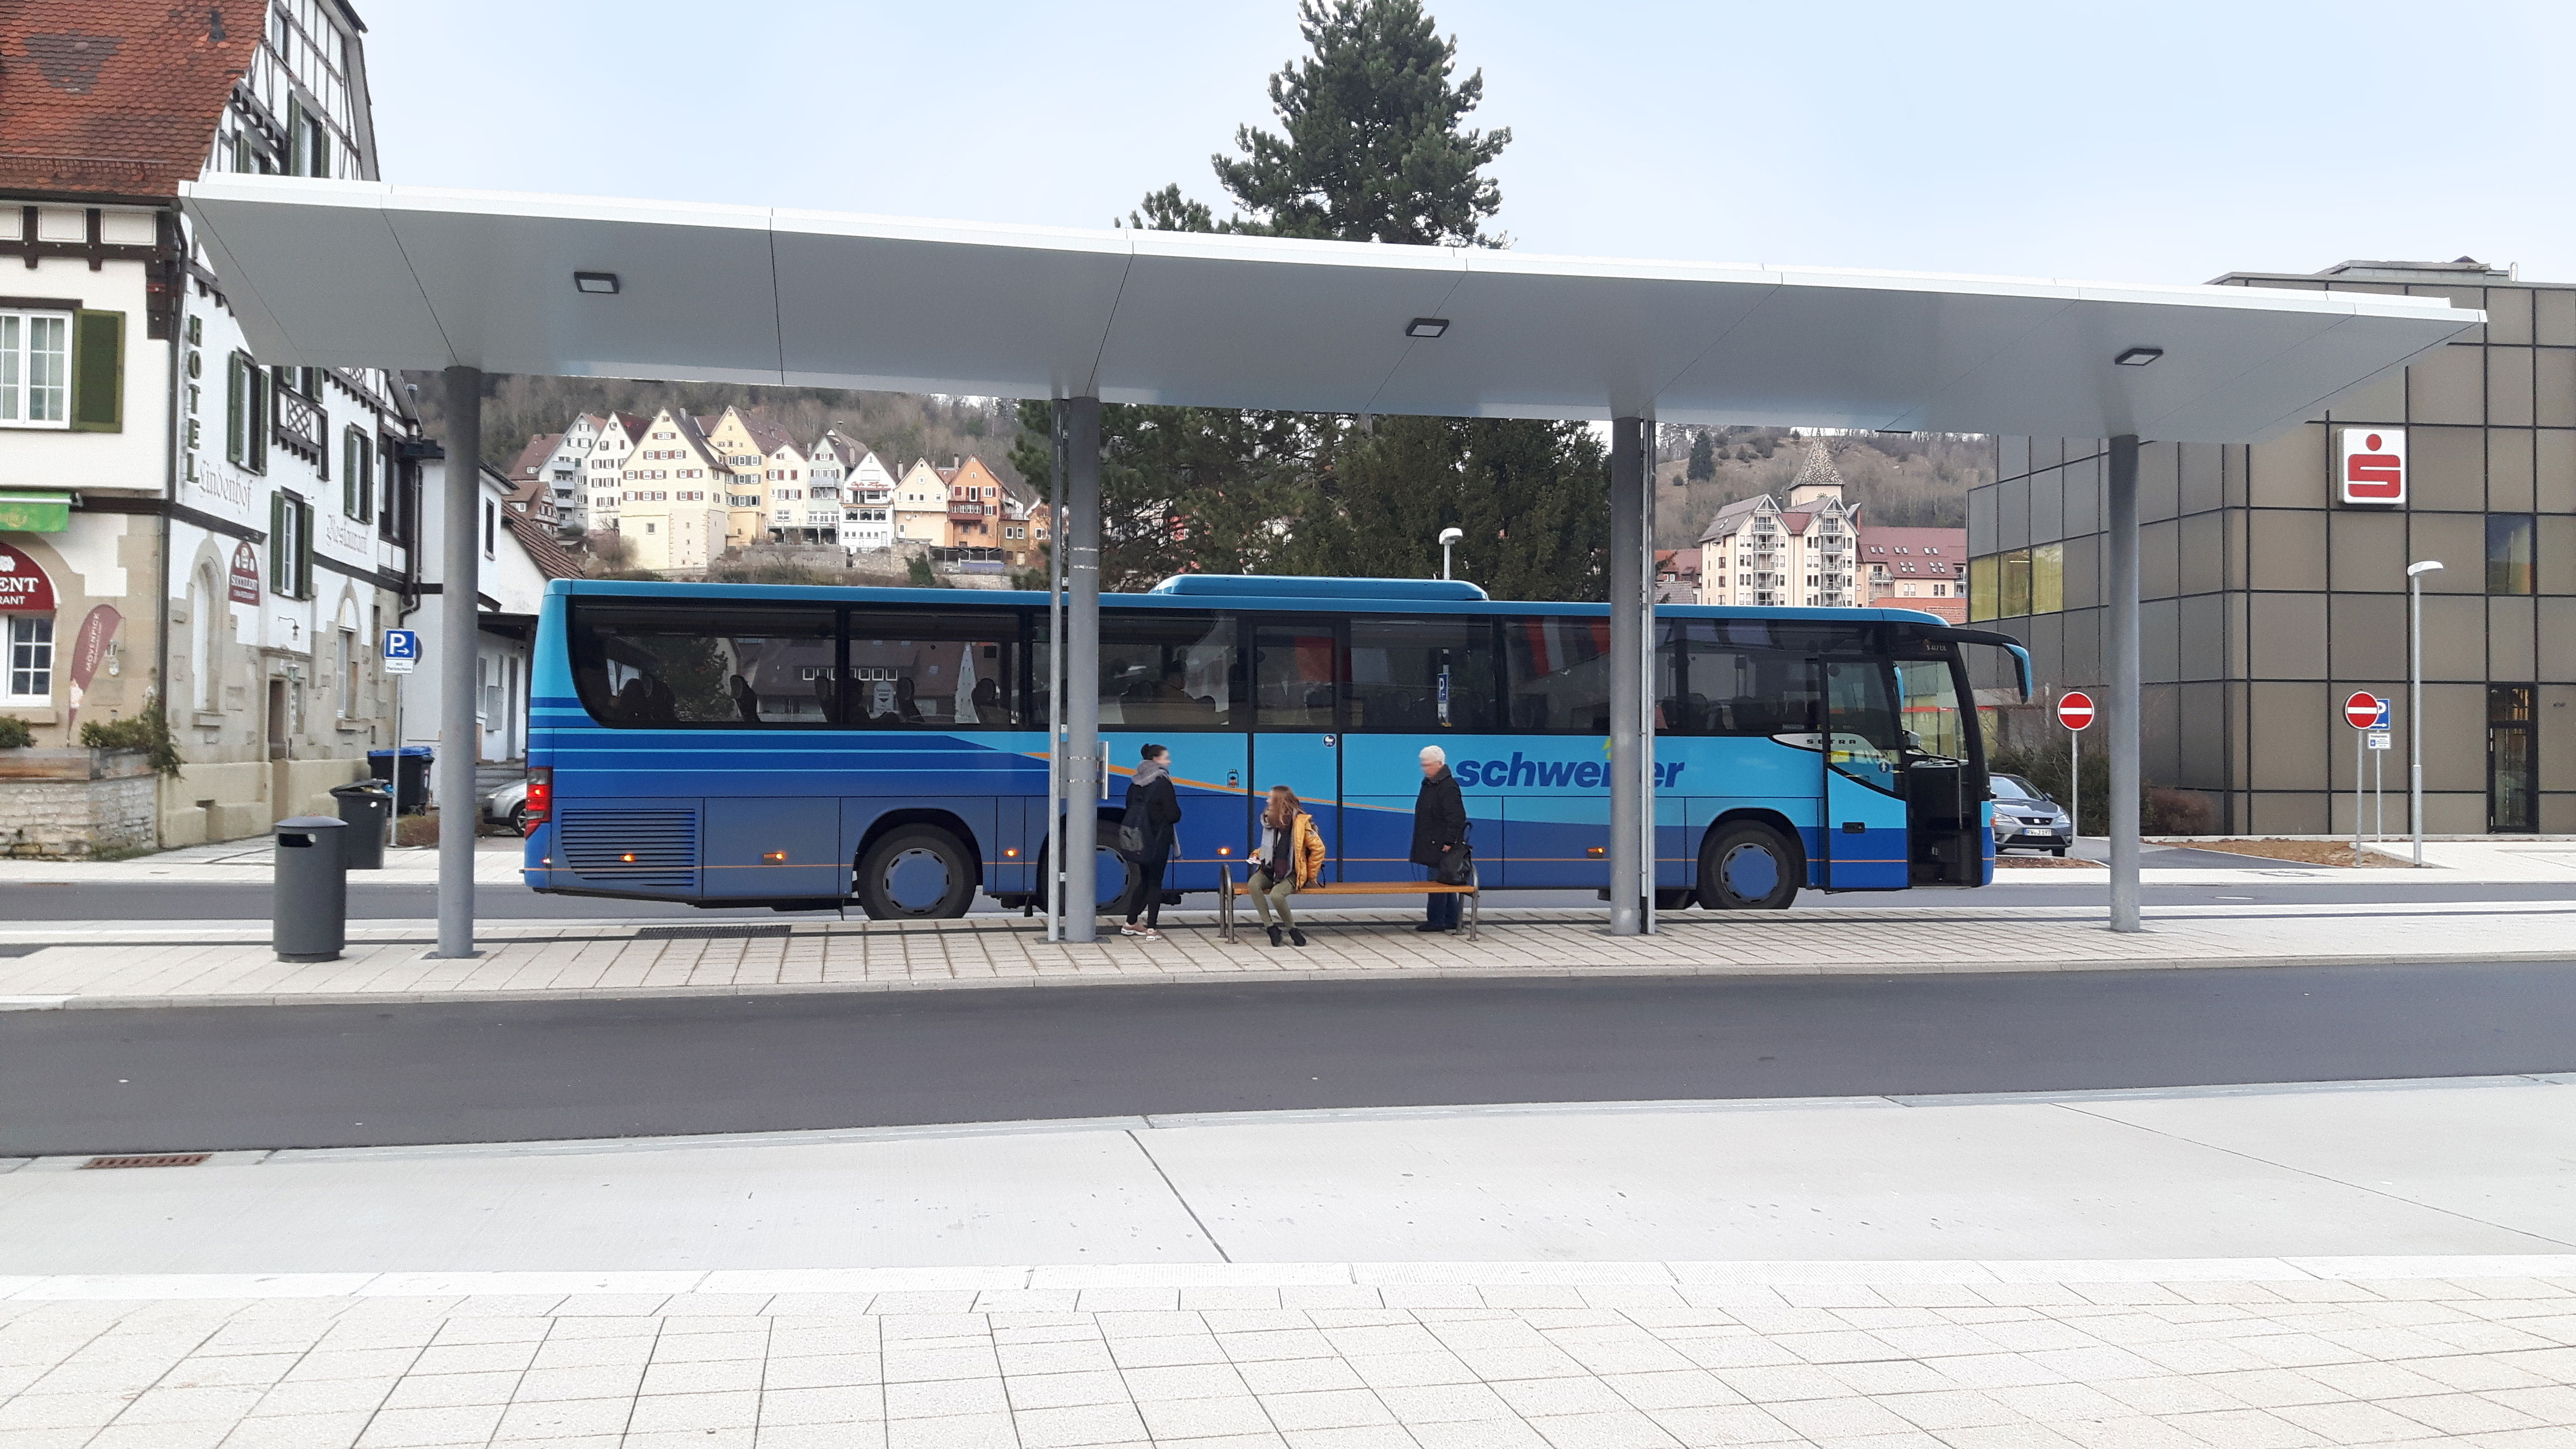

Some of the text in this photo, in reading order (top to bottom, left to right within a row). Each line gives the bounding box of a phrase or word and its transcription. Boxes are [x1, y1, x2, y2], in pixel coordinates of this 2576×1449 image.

[187, 314, 203, 484] HOTEL
[389, 633, 406, 655] P
[1439, 678, 1445, 698] P
